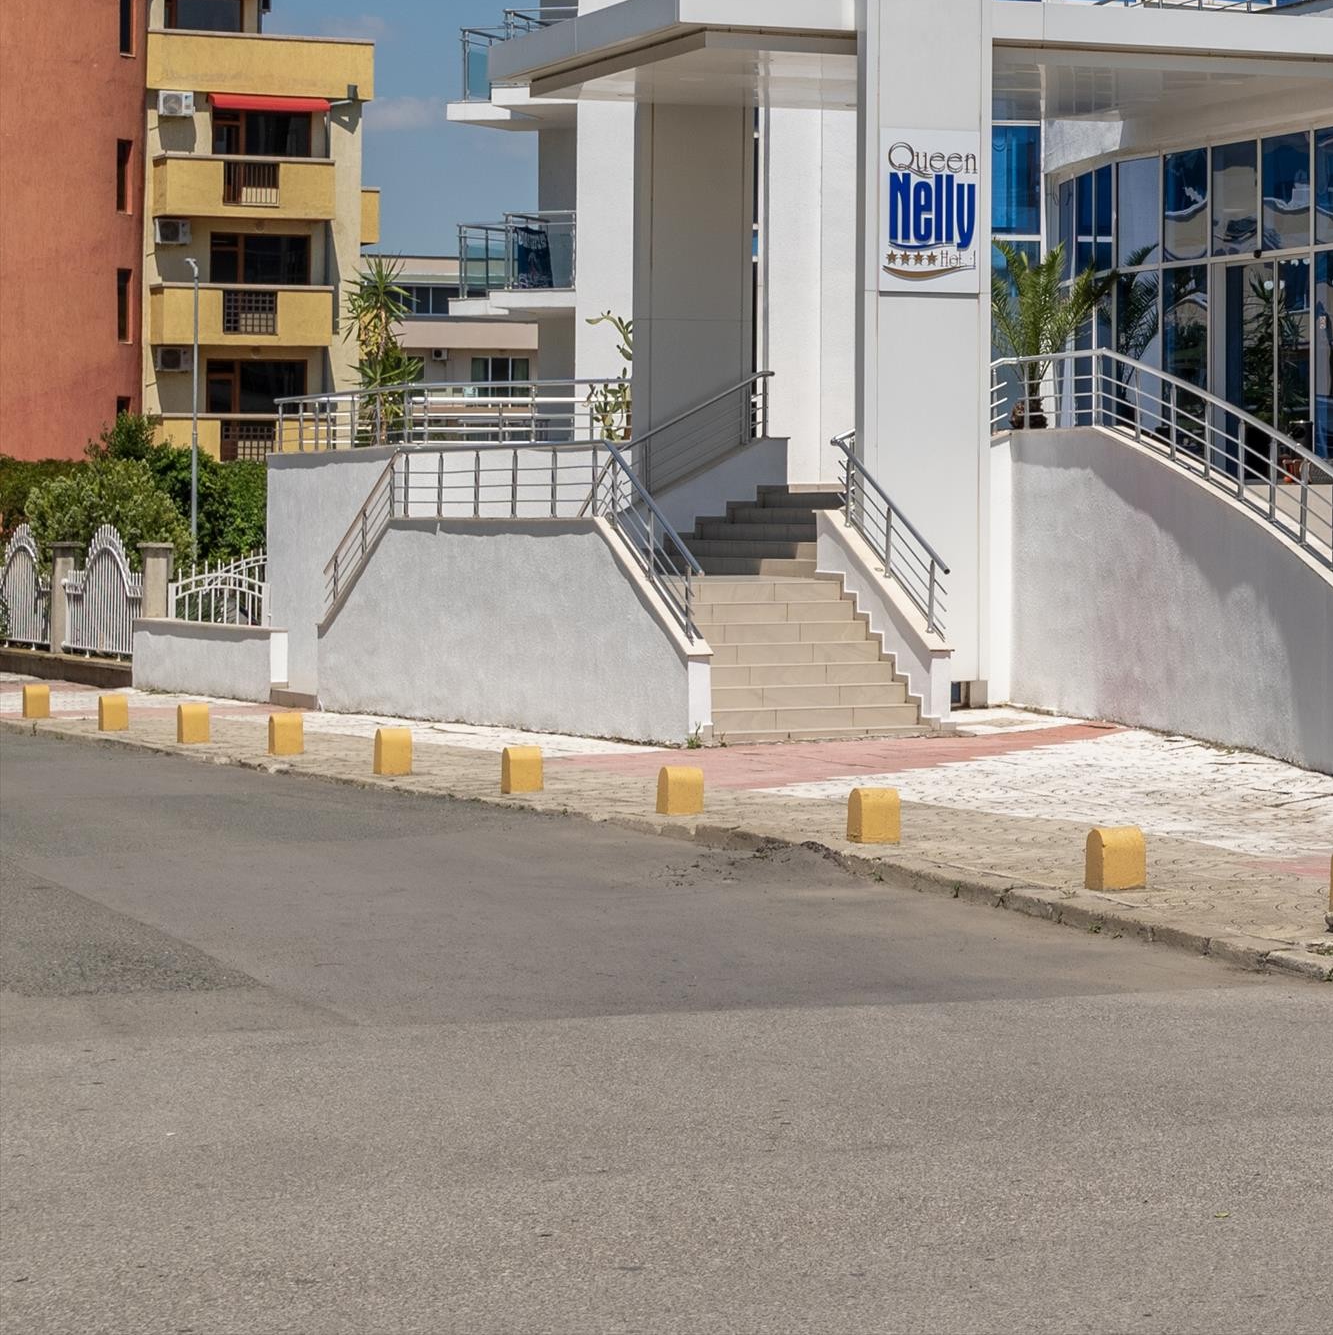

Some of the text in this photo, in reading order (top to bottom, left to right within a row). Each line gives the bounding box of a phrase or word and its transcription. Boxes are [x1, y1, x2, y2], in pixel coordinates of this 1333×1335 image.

[888, 142, 978, 179] Queen
[889, 172, 976, 251] Nelly
[940, 250, 976, 267] Hotl
